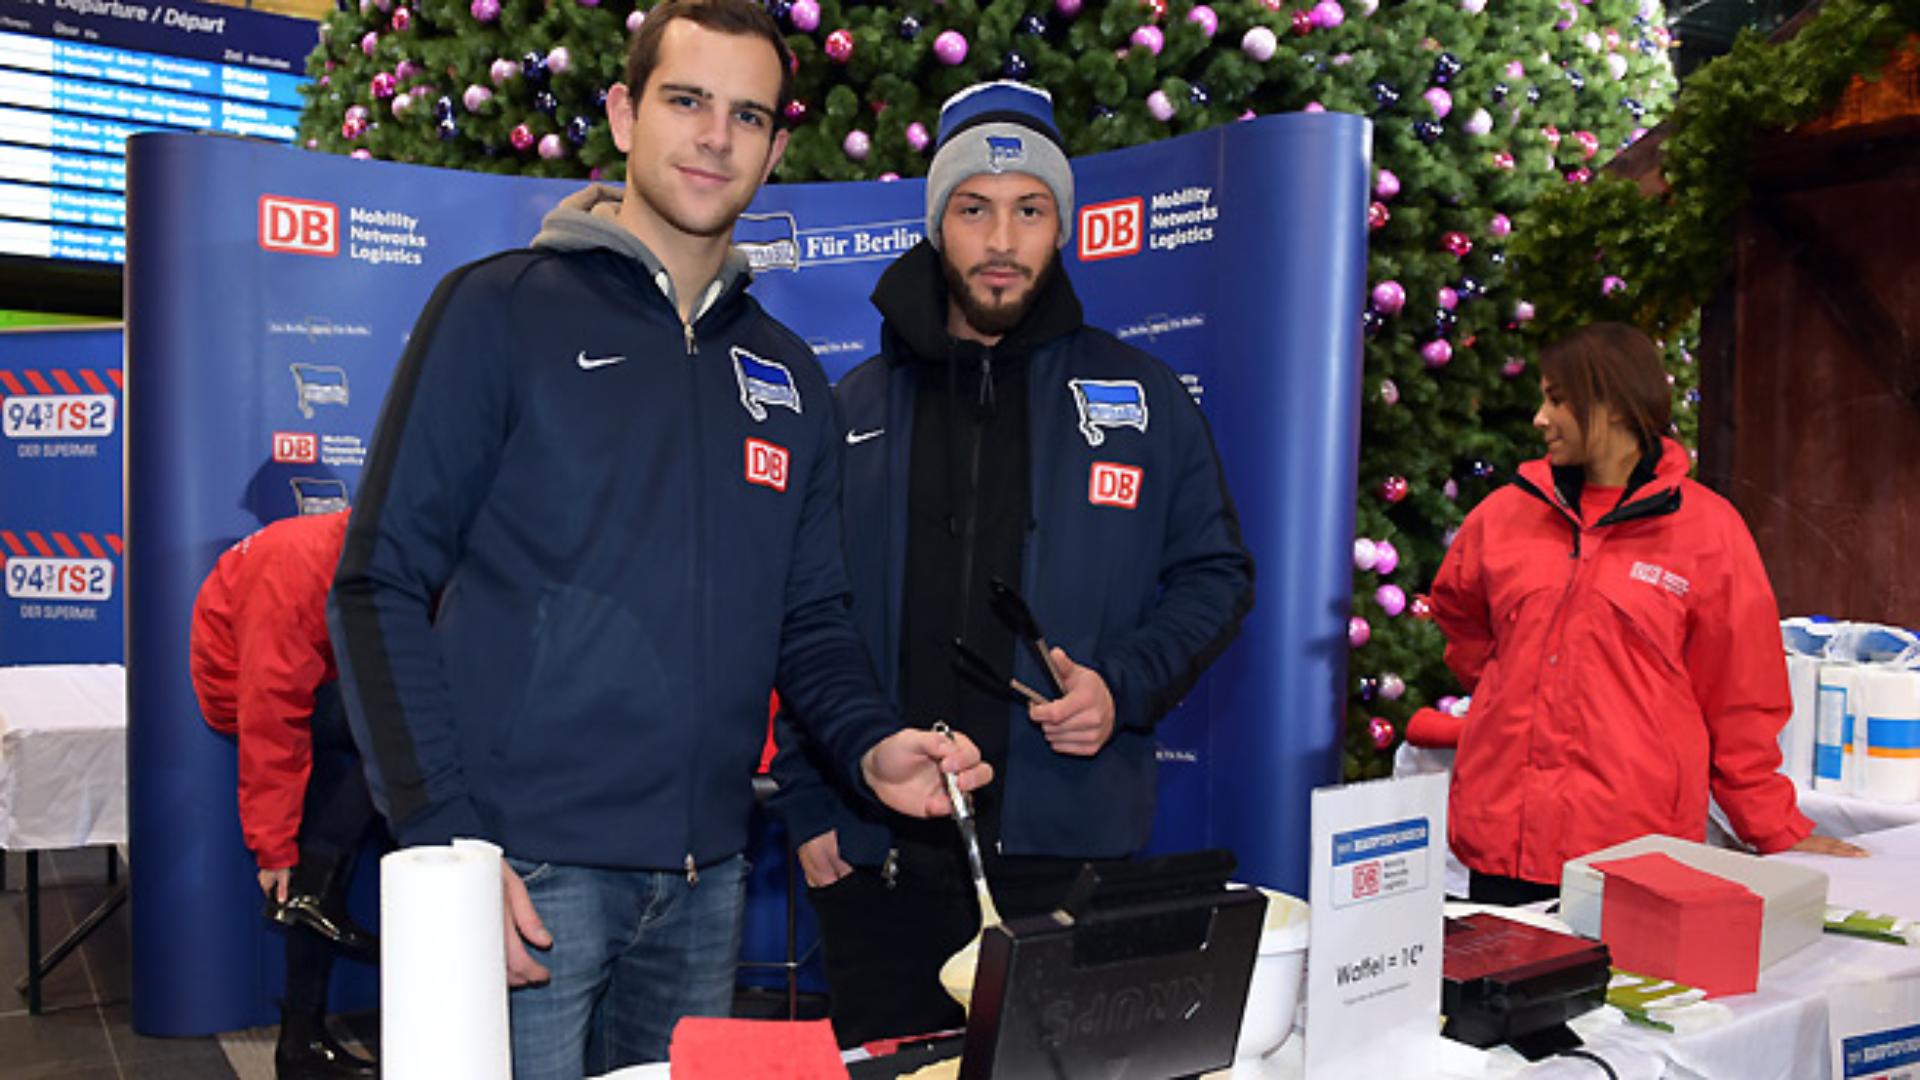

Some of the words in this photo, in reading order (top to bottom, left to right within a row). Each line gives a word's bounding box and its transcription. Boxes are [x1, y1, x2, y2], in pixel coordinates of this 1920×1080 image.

[164, 8, 225, 33] Départ
[1152, 187, 1212, 211] Mobility
[270, 204, 329, 247] DB
[350, 207, 418, 231] Mobility
[1087, 208, 1134, 250] DB
[1151, 206, 1218, 229] Networks
[350, 226, 428, 247] Networks
[806, 236, 849, 258] Für
[853, 227, 922, 254] Berlin
[1149, 226, 1214, 249] Logistics
[350, 243, 423, 265] Logistics
[280, 438, 311, 457] DB
[753, 446, 783, 481] DB
[1096, 470, 1134, 501] DB
